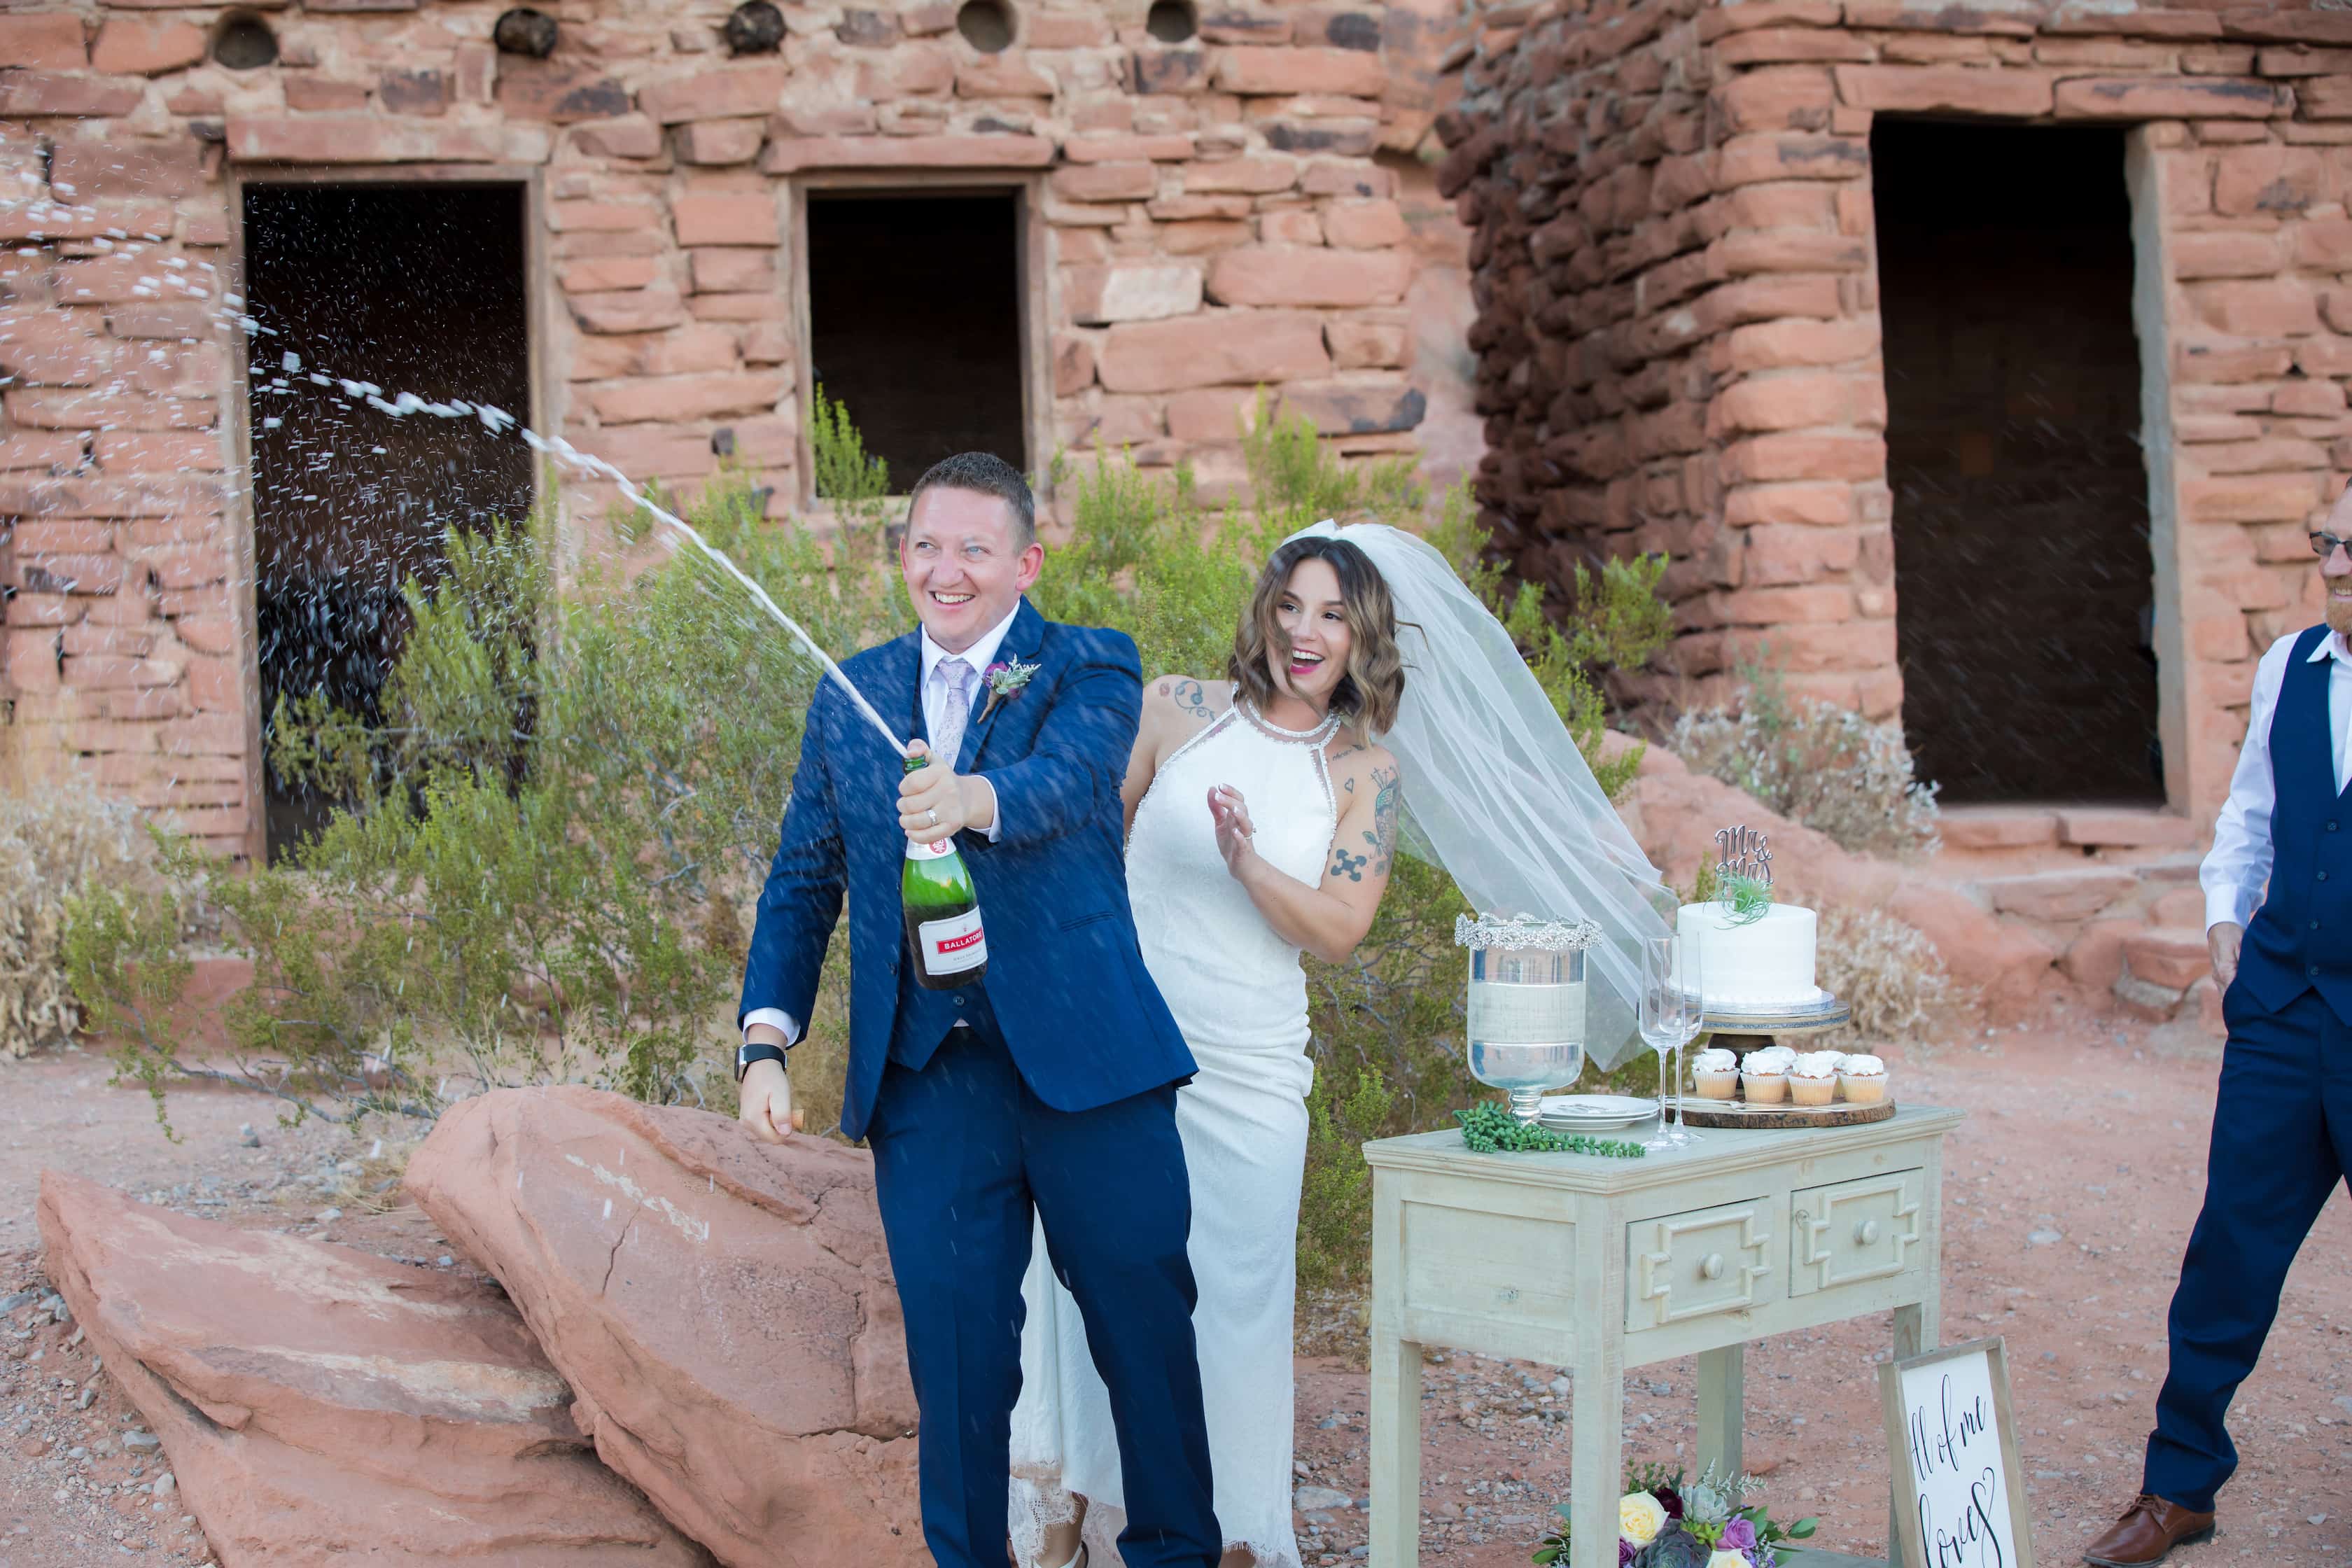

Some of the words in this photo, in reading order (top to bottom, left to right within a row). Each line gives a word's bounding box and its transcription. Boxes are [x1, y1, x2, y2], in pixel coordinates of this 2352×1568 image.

[1715, 825, 1758, 864] Mr
[1716, 856, 1774, 893] Mrs
[1911, 1405, 1933, 1484] ll
[1936, 1373, 1959, 1471] of
[1960, 1395, 1987, 1448] me
[1919, 1466, 2003, 1568] loves
